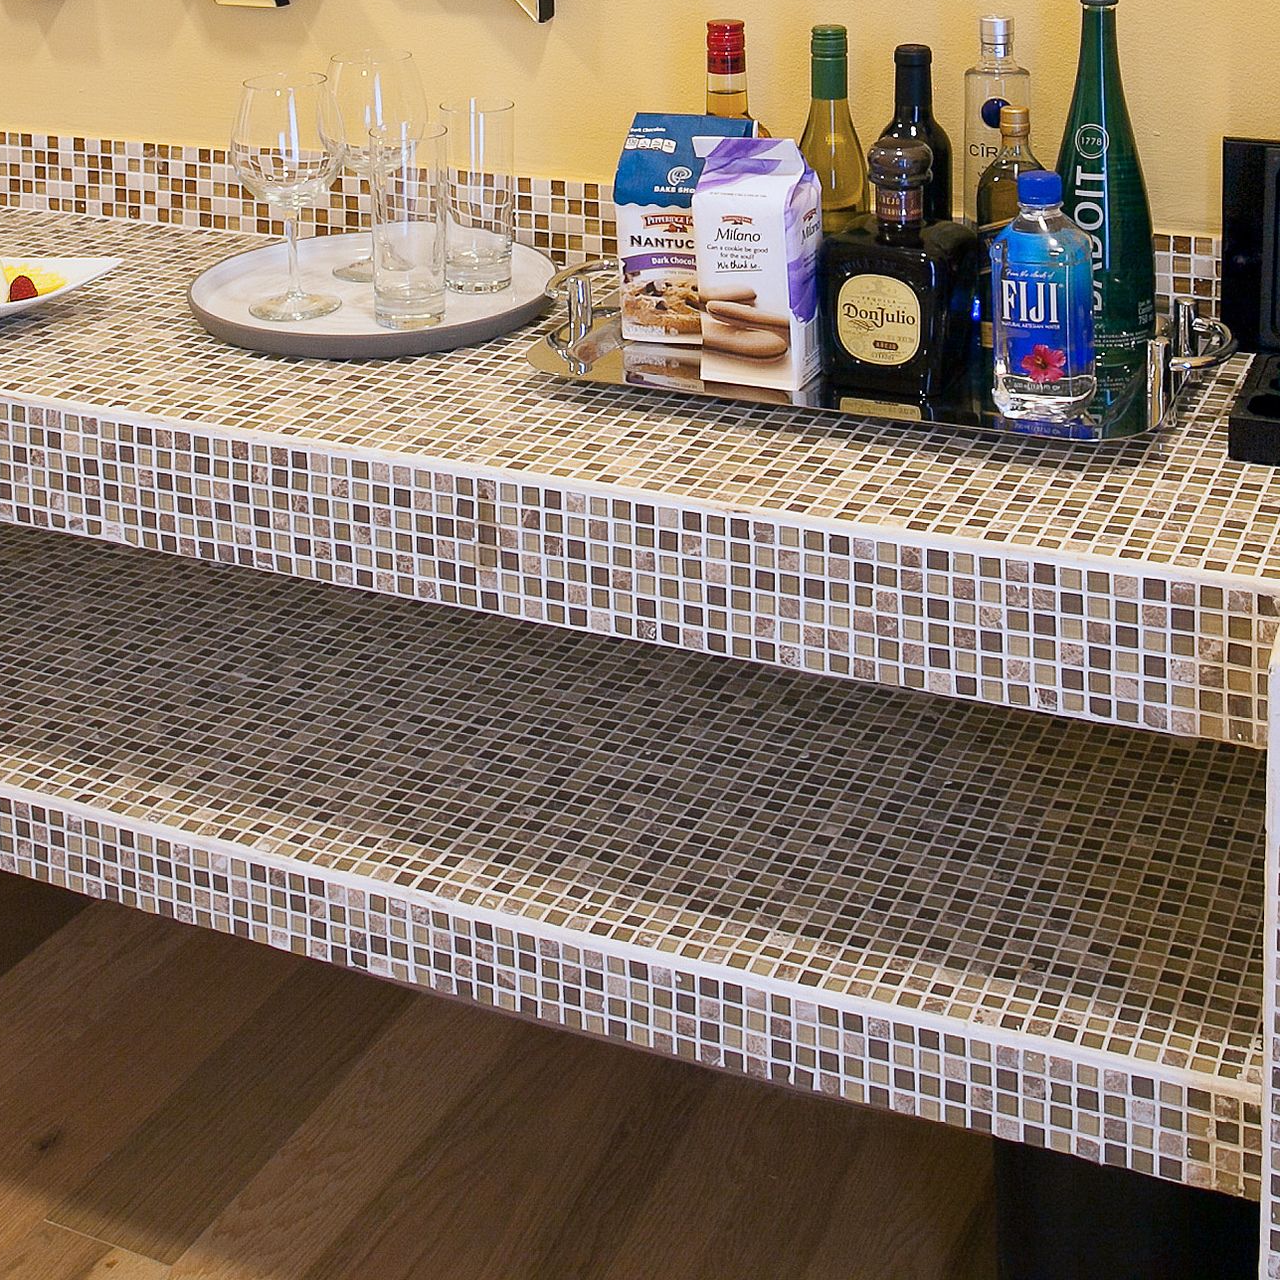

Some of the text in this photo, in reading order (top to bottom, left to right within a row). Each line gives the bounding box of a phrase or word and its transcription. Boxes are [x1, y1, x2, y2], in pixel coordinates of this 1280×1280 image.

[1081, 136, 1102, 146] 1778
[970, 143, 998, 158] CÎR
[714, 227, 761, 242] Milano
[630, 235, 695, 249] NANTUC
[651, 256, 695, 265] Dark Chocol
[717, 261, 728, 269] We
[730, 260, 747, 269] think
[1001, 279, 1059, 323] FIJI
